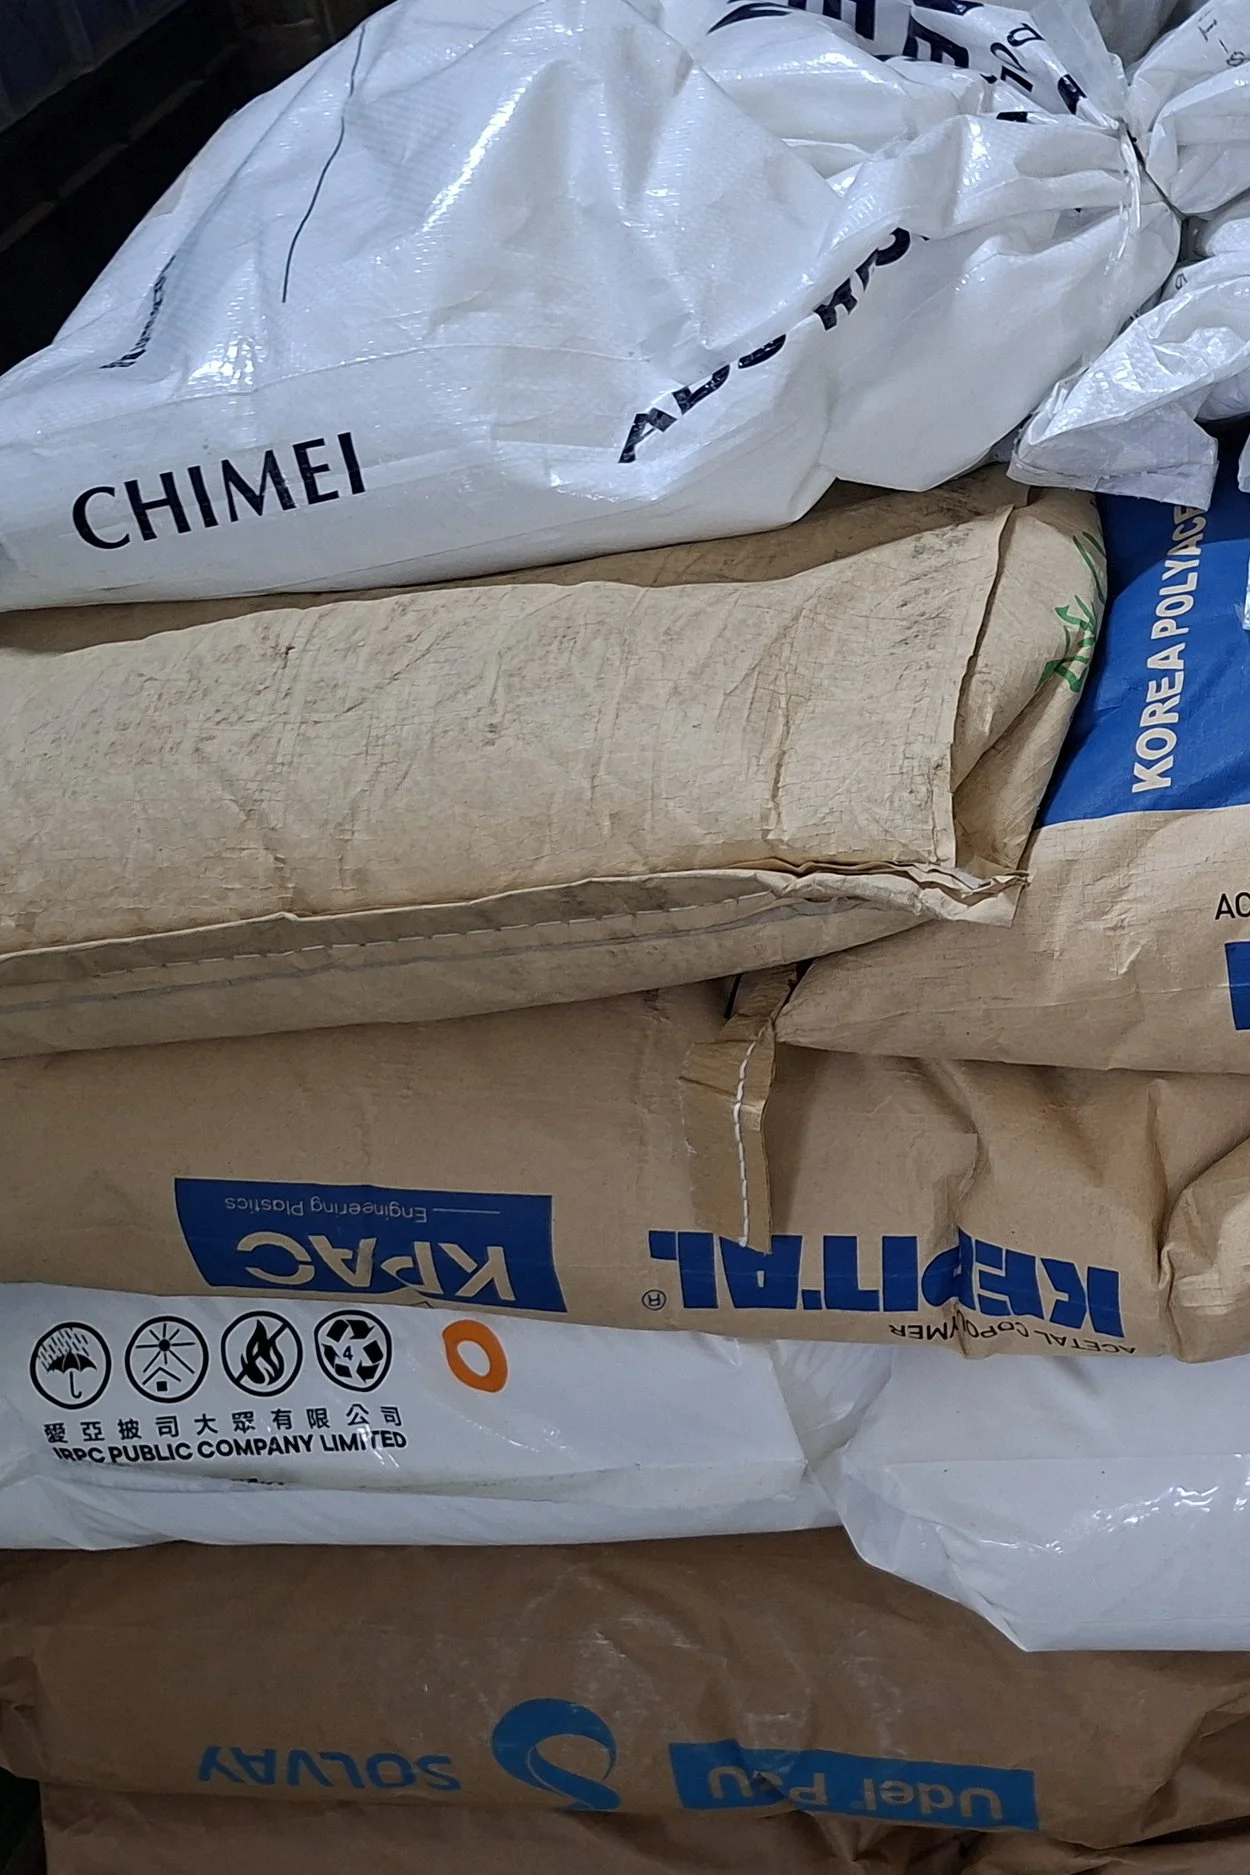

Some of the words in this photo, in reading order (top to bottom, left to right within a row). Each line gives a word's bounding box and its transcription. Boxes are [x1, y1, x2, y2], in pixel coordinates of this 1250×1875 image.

[72, 433, 367, 551] CHIMEI
[1131, 642, 1187, 794] KOREA
[225, 1194, 304, 1218] Plastics
[310, 1195, 428, 1224] Engineering
[236, 1230, 517, 1301] KPAC
[648, 1225, 1126, 1339] KEPITAL
[1034, 1329, 1137, 1356] ACETAL
[111, 1442, 193, 1465] PUBLIC
[196, 1434, 313, 1459] COMPANY
[319, 1430, 407, 1453] LIMITED
[197, 1746, 462, 1791] SOLVAY
[864, 1776, 1001, 1820] Udel
